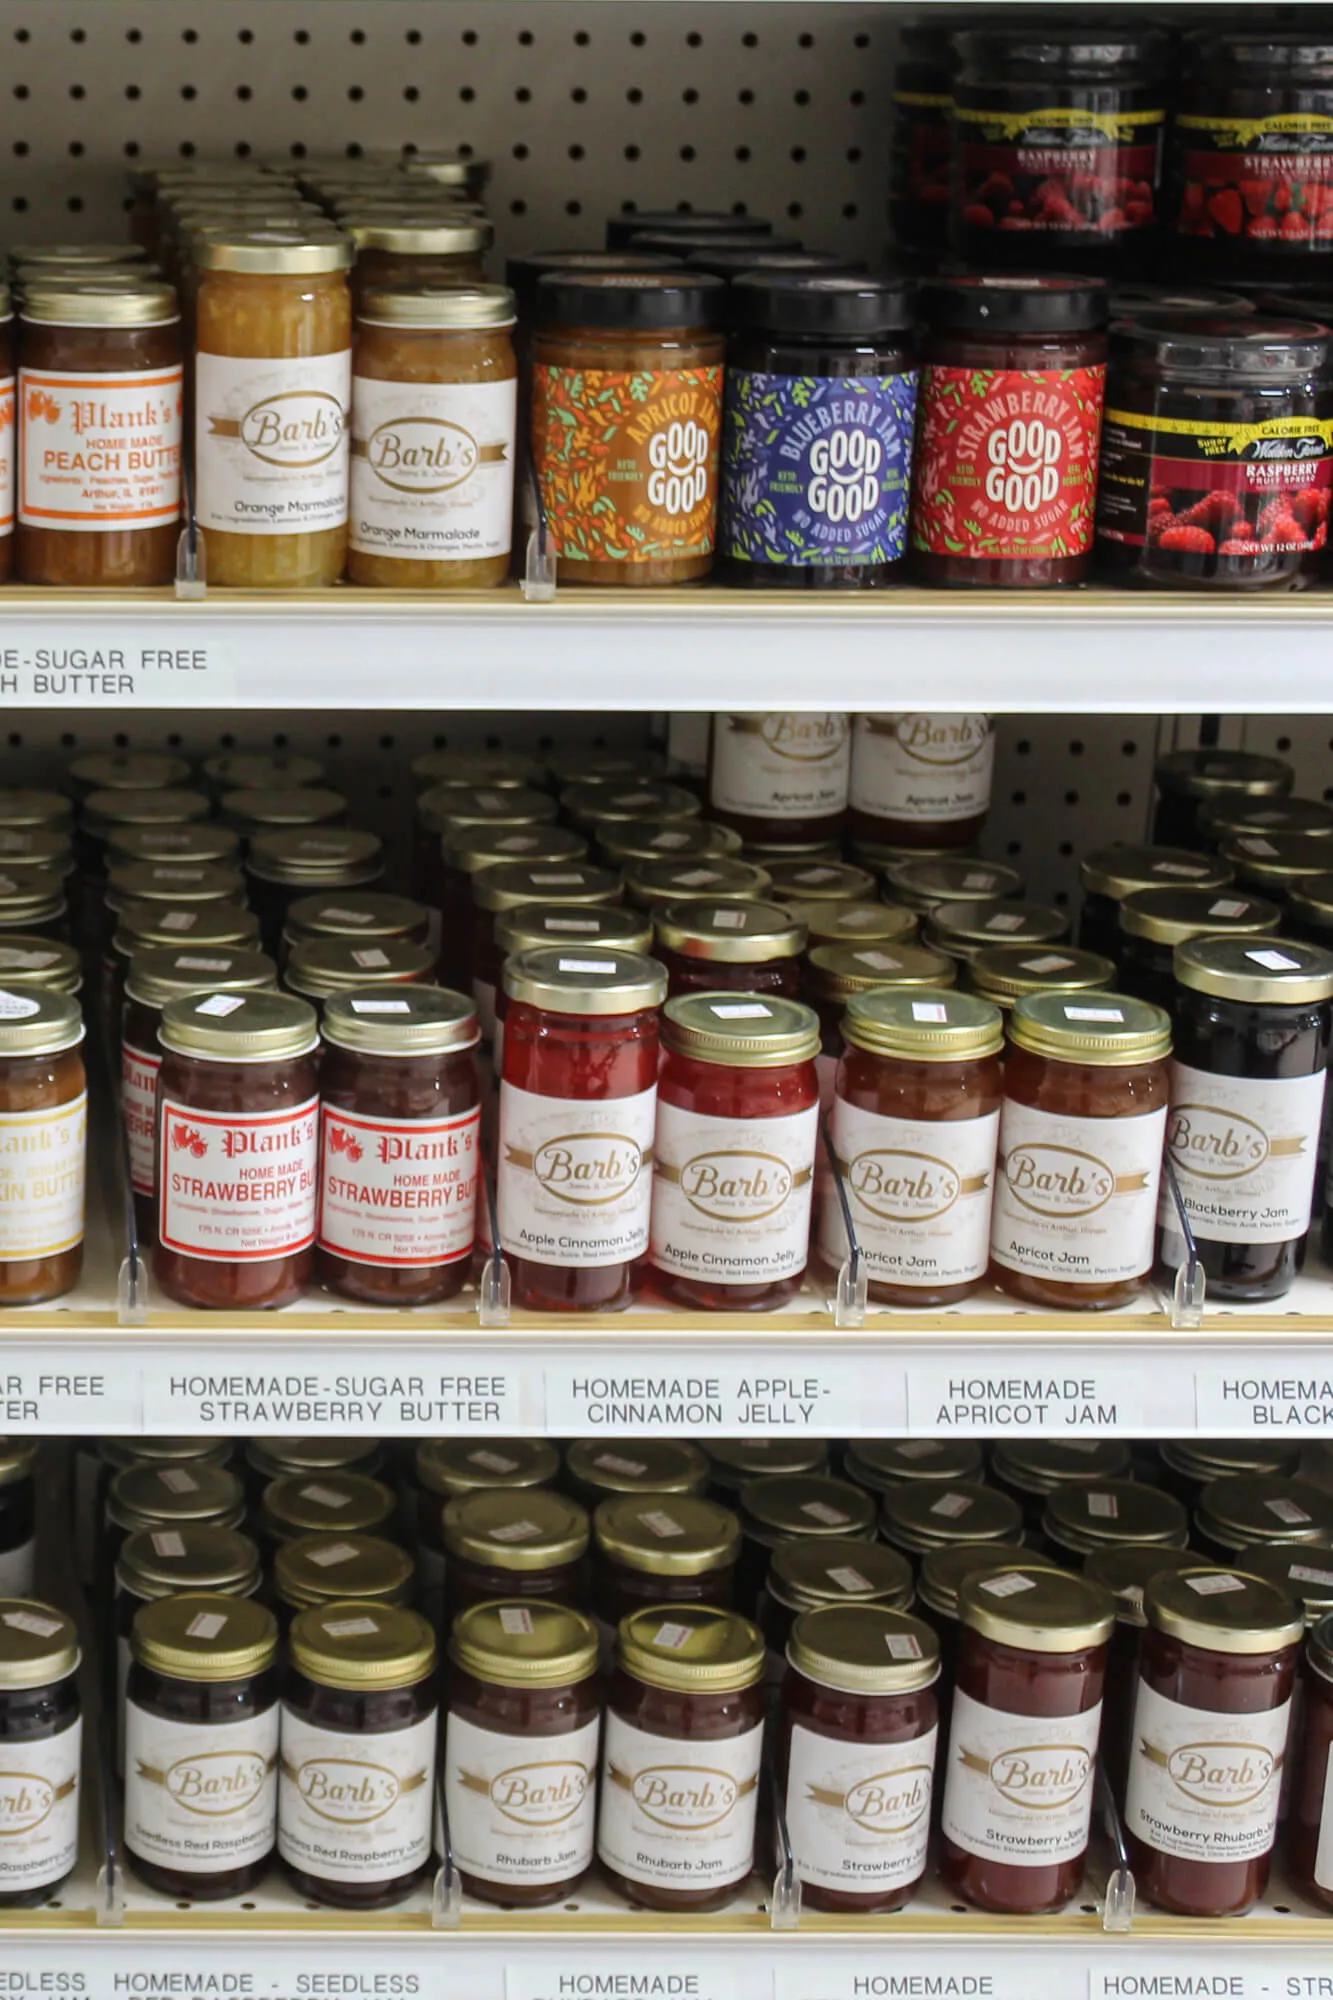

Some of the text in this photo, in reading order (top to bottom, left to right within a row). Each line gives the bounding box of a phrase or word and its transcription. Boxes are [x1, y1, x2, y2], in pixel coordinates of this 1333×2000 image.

[70, 400, 172, 435] Plank's
[246, 408, 342, 448] Barb's
[625, 391, 699, 445] APRICOT
[955, 390, 1070, 462] STRAWBERRY
[1062, 415, 1085, 460] JAM
[779, 400, 901, 462] BLUEBERRY JAM
[1262, 425, 1301, 435] CALORIE
[374, 432, 475, 469] Barb's
[649, 420, 709, 470] GOOD
[809, 429, 881, 476] GOOD
[987, 419, 1062, 466] GOOD
[44, 449, 121, 471] PEACH
[1246, 462, 1319, 477] RASPBERRY
[647, 466, 708, 515] GOOD
[985, 465, 1060, 513] GOOD
[1249, 476, 1280, 485] FRUIT
[234, 500, 285, 517] Orange
[807, 475, 880, 523] GOOD
[810, 521, 851, 542] ADDED
[855, 508, 887, 540] SUGAR
[988, 511, 1030, 533] ADDED
[1034, 499, 1069, 530] SUGAR
[360, 520, 481, 542] Orange Marmalade
[0, 649, 207, 670] E-SUGAR FREE
[33, 674, 135, 694] BUTTER
[221, 1121, 314, 1159] Plank's
[375, 1131, 473, 1164] Plank's
[1170, 1115, 1264, 1159] Barb's
[239, 1158, 304, 1181] HOME MADE
[540, 1147, 639, 1183] Barb's
[1008, 1154, 1110, 1196] Barb's
[172, 1173, 296, 1202] STRAWBERRY
[394, 1169, 461, 1187] HOME MADE
[688, 1163, 790, 1199] Barb's
[854, 1160, 956, 1200] Barb's
[328, 1176, 453, 1208] STRAWBERRY
[1183, 1198, 1289, 1220] Blackberry Jam
[519, 1227, 646, 1250] Apple Cinnamon Jelly
[664, 1242, 796, 1268] Apple Cinnamon Jelly
[856, 1246, 937, 1269] Apricot Jam
[1009, 1240, 1090, 1265] Apricot Jam
[0, 1376, 105, 1396] R FREE
[170, 1376, 506, 1397] HOMEMADE-SUGAR FREE
[572, 1378, 831, 1399] HOMEMADE APPLE-
[948, 1379, 1096, 1400] HOMEMADE
[1223, 1379, 1333, 1400] HOMEMA
[0, 1401, 40, 1420] ER
[200, 1401, 501, 1422] STRAWBERRY BUTTER
[587, 1403, 815, 1424] CINNAMON JELLY
[936, 1404, 1117, 1425] APRICOT JAM
[1253, 1404, 1333, 1425] BLACK
[999, 1757, 1088, 1790] Barb's
[1174, 1751, 1273, 1785] Barb's
[172, 1763, 264, 1798] Barb's
[304, 1767, 396, 1804] Barb's
[497, 1774, 586, 1808] Barb's
[637, 1775, 734, 1808] Barb's
[985, 1828, 1062, 1846] Strawberry
[1063, 1826, 1084, 1842] Jam
[1139, 1808, 1211, 1844] Strawberry
[1213, 1829, 1264, 1843] Rhubarb
[184, 1838, 209, 1851] Red
[313, 1844, 338, 1860] Red
[339, 1847, 406, 1864] Raspberry
[496, 1848, 578, 1867] Rhubarb Jam
[636, 1852, 723, 1871] Rhubarb Jam
[841, 1855, 912, 1872] Strawberry
[114, 1972, 253, 1992] HOMEMADE
[296, 1974, 420, 1993] SEEDLESS
[559, 1975, 699, 1994] HOMEMADE
[853, 1976, 993, 1995] HOMEMADE
[1104, 1976, 1245, 1996] HOMEMADE
[1286, 1976, 1333, 1996] STR
